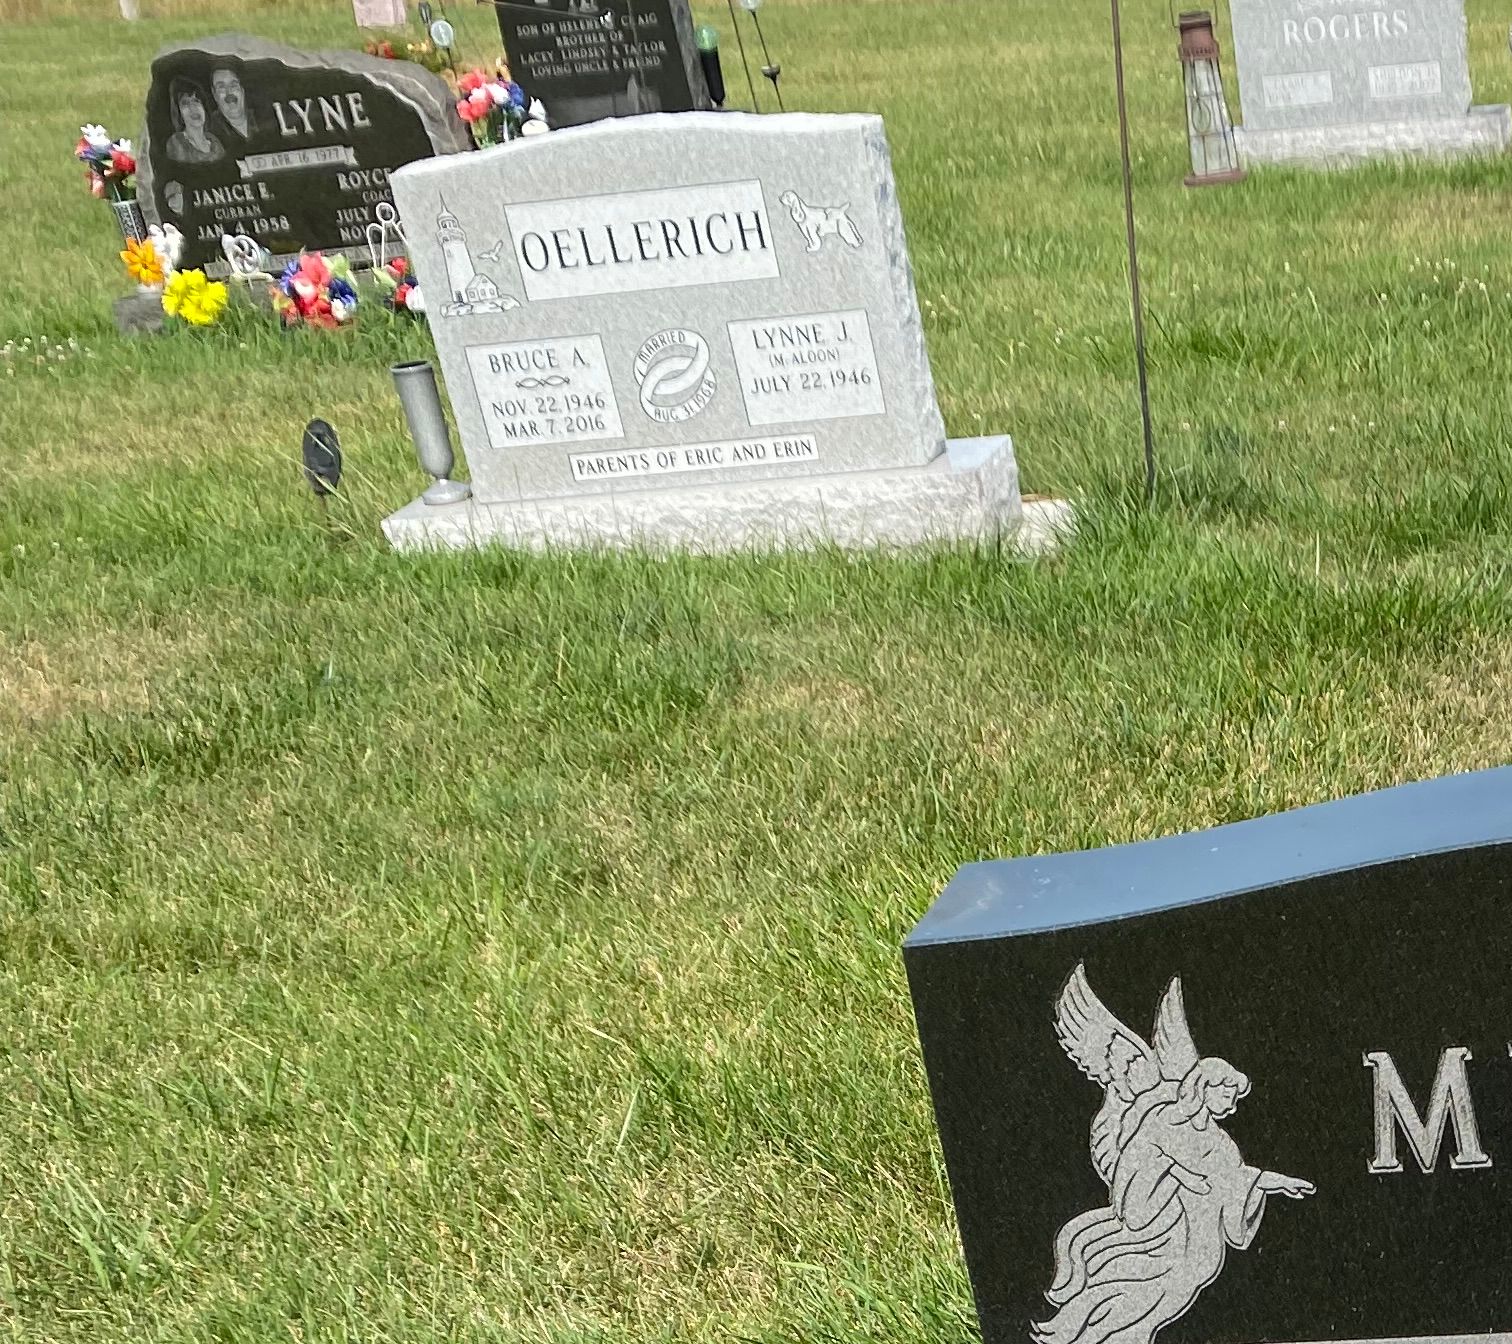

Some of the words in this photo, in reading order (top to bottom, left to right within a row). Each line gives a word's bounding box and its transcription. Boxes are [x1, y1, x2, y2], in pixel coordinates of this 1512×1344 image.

[516, 24, 539, 37] SON
[542, 22, 556, 35] OF
[1282, 9, 1409, 46] ROGERS
[555, 32, 606, 48] BROTHER
[609, 30, 624, 42] OF
[519, 49, 554, 65] LACEY
[561, 46, 607, 60] LINDSEY
[531, 62, 572, 78] LOVING
[574, 59, 609, 73] UNCLE
[273, 92, 372, 136] LYNE
[315, 148, 341, 163] 1977
[192, 184, 255, 207] JANICE
[214, 203, 262, 220] CURRAN
[335, 206, 370, 225] JULY
[252, 214, 290, 234] 1958
[520, 210, 768, 272] OELLERICH
[638, 330, 686, 363] MARRIED
[752, 323, 825, 350] LYNNE
[488, 348, 560, 375] BRUCE
[750, 374, 791, 395] JULY
[830, 367, 872, 388] 1946
[564, 392, 606, 413] 1946
[564, 414, 606, 434] 2016
[576, 453, 651, 477] PARENTS
[656, 451, 678, 470] OF
[685, 447, 723, 467] ERIC
[732, 443, 766, 463] AND
[773, 439, 813, 460] ERIN
